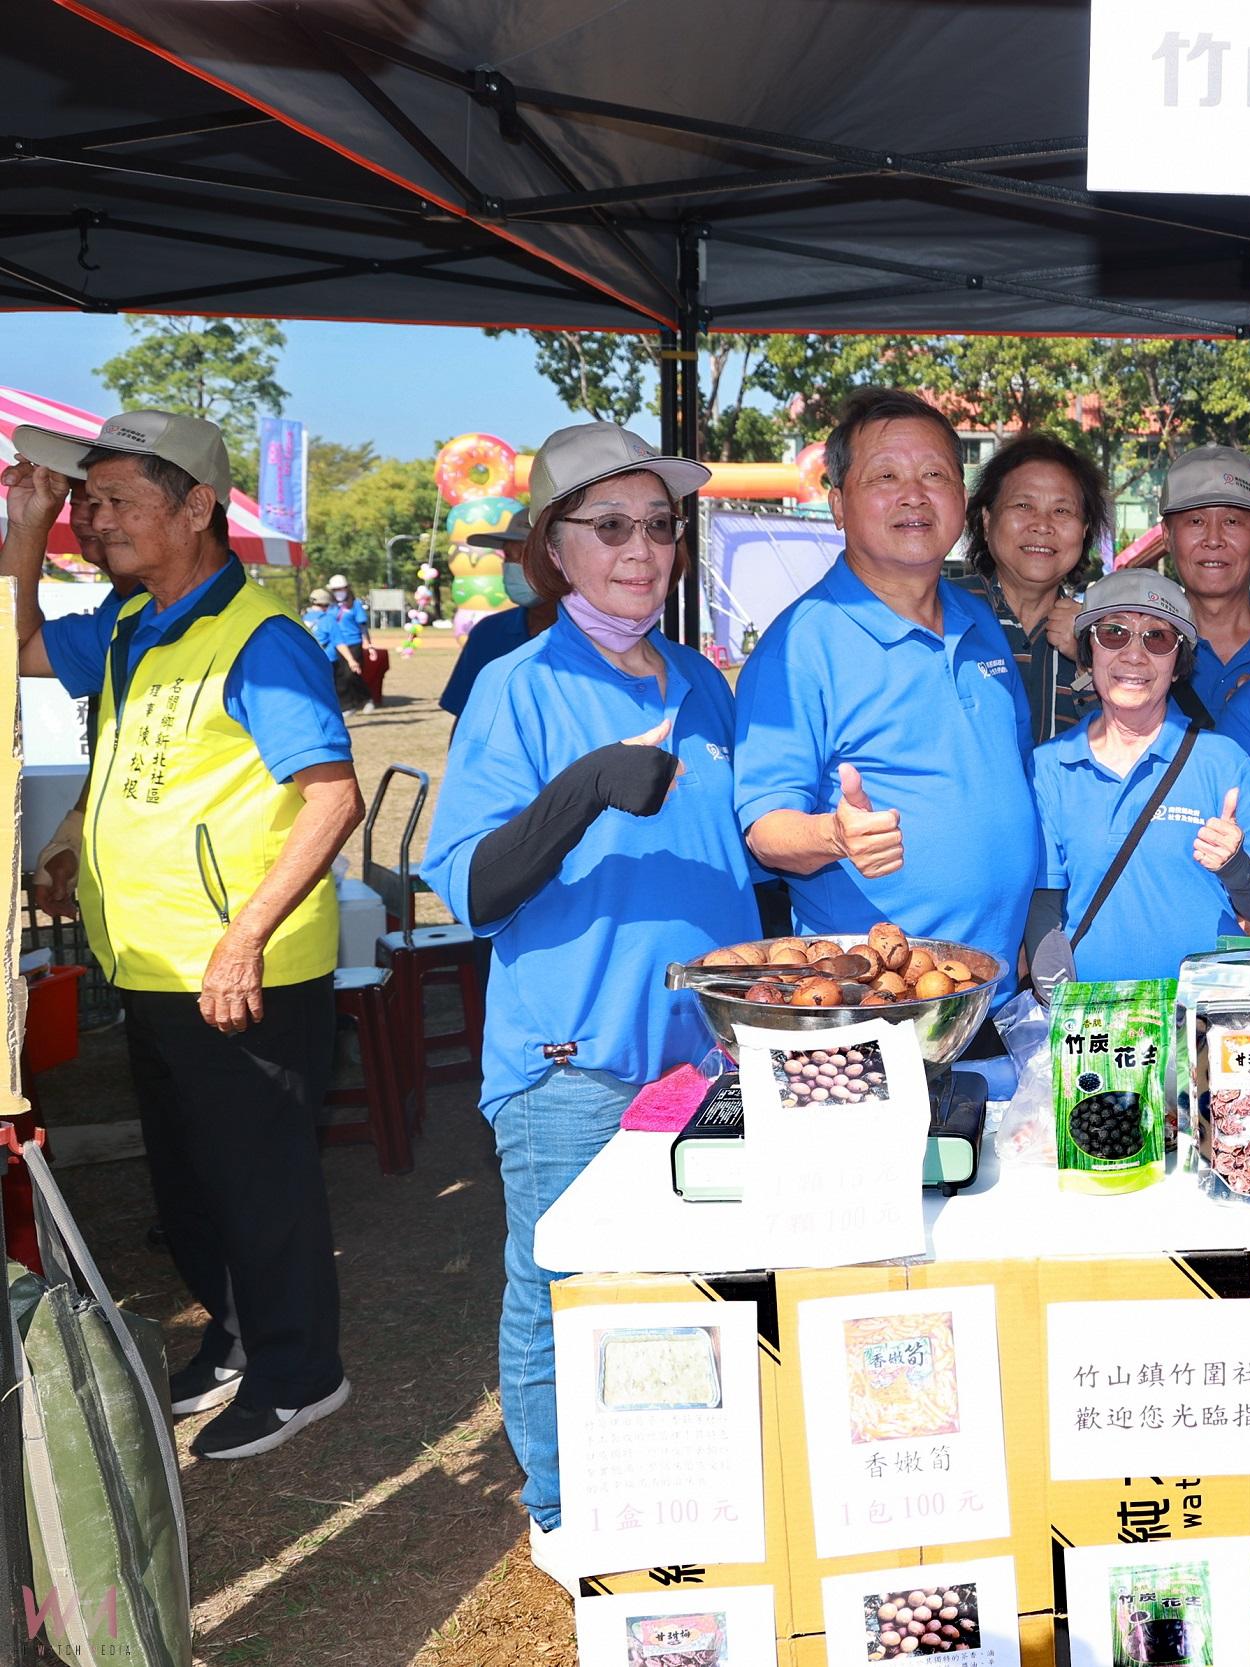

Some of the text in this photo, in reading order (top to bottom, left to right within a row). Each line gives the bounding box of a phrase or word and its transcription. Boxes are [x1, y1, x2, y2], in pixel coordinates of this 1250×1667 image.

[1065, 1033, 1158, 1069] 竹炭花生
[864, 1445, 952, 1479] 香嫩筍
